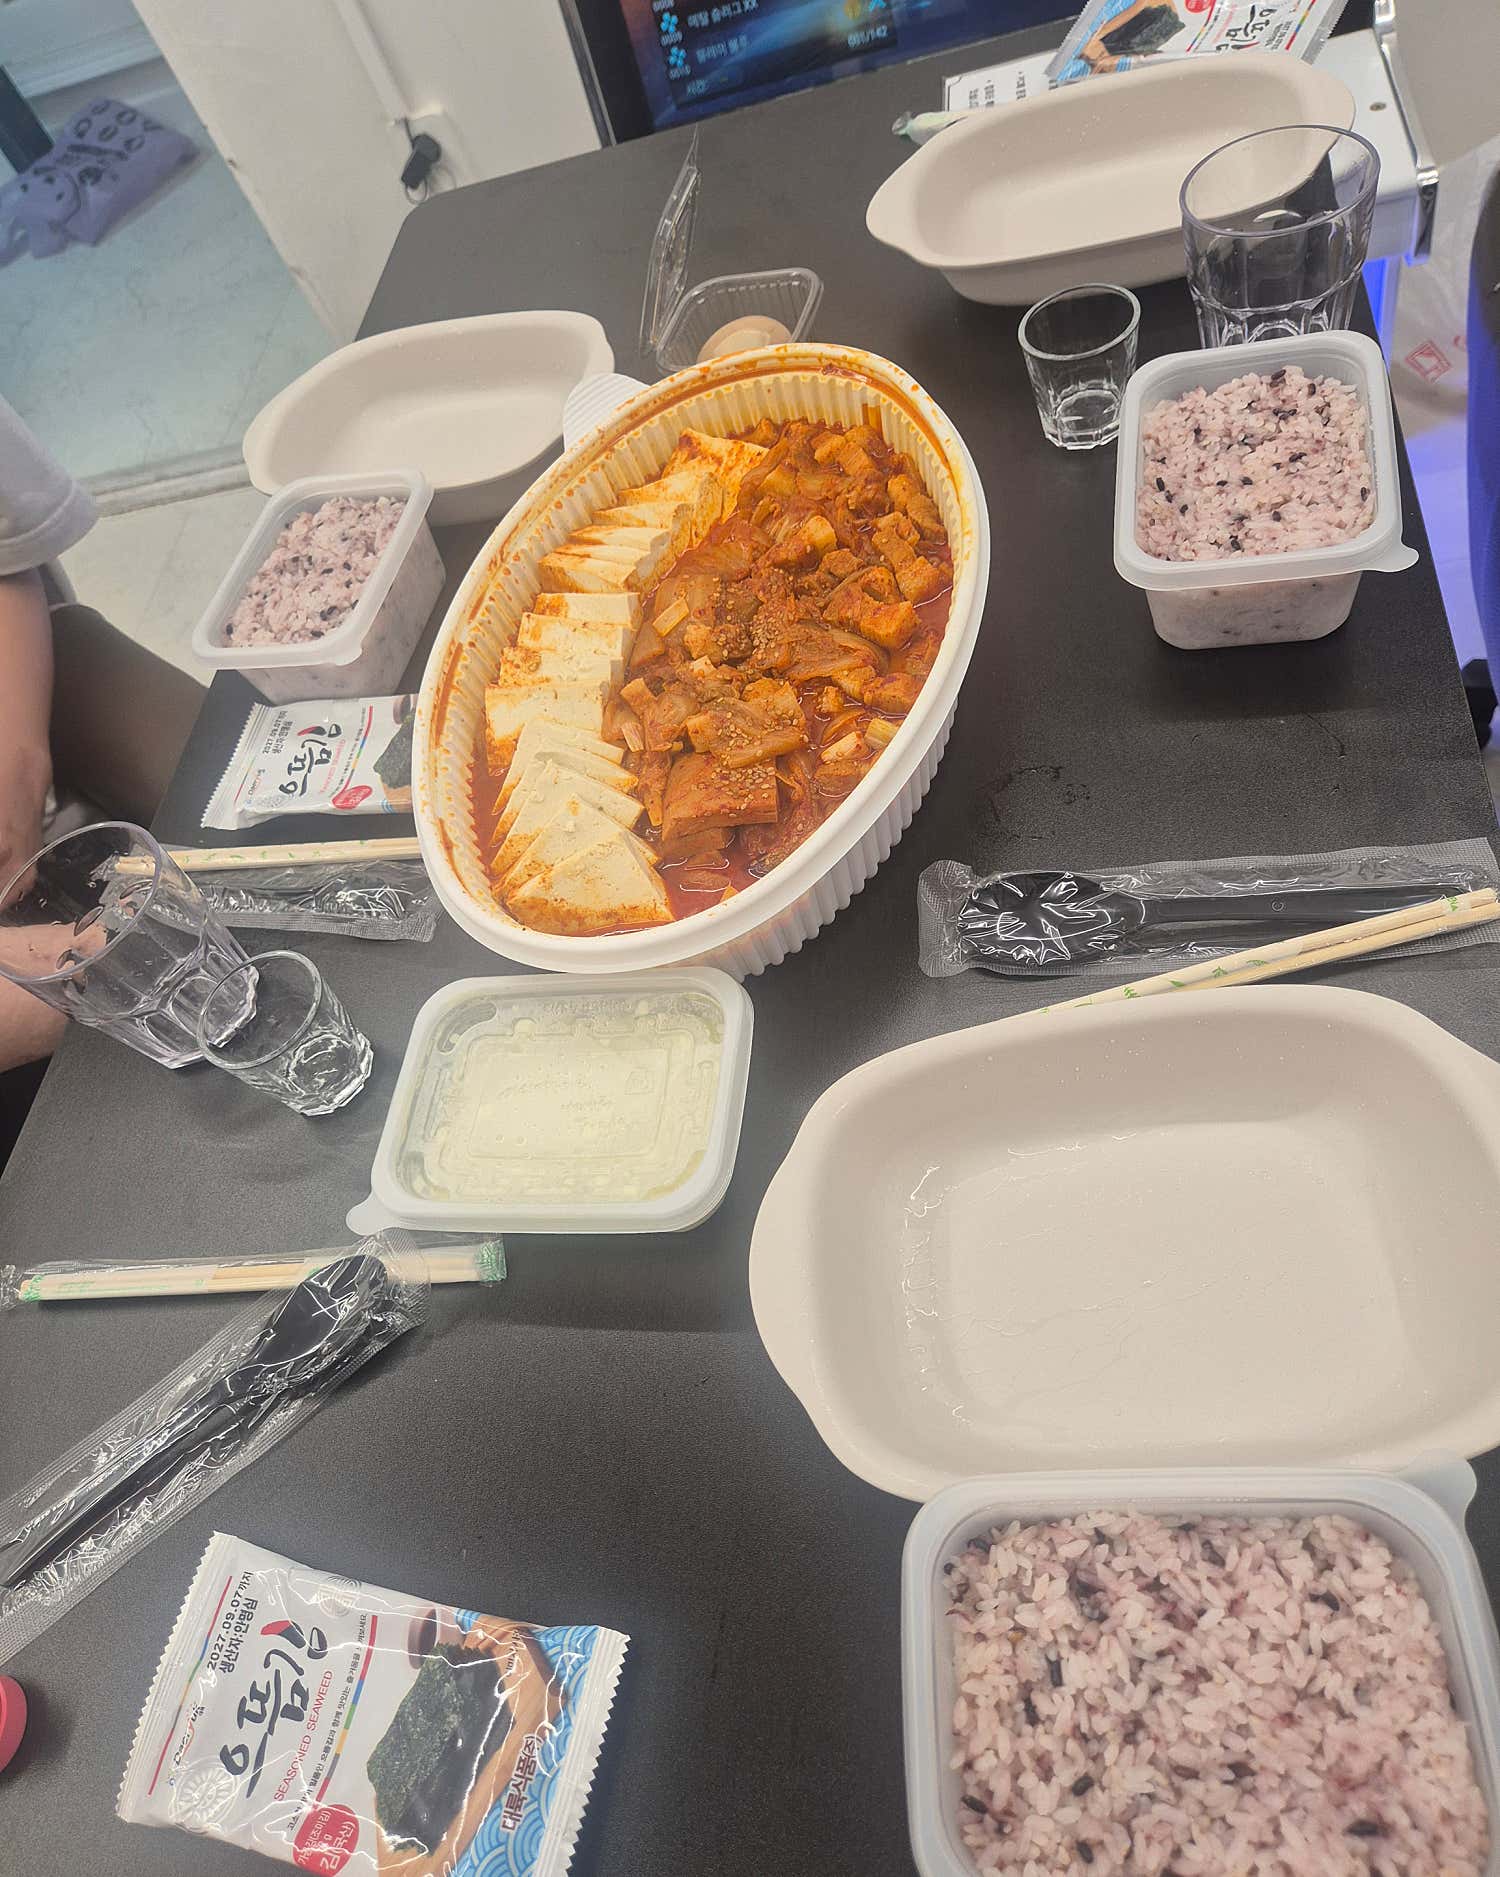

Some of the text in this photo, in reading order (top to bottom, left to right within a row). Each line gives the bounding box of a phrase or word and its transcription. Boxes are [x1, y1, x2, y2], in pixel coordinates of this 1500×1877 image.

[278, 723, 343, 797] 으뜸김
[207, 1571, 255, 1672] 2027.09.07까지
[219, 1598, 258, 1674] 생산자:안명심
[219, 1619, 329, 1799] 으뜸김
[274, 1670, 334, 1801] SEASONED SEAWEED
